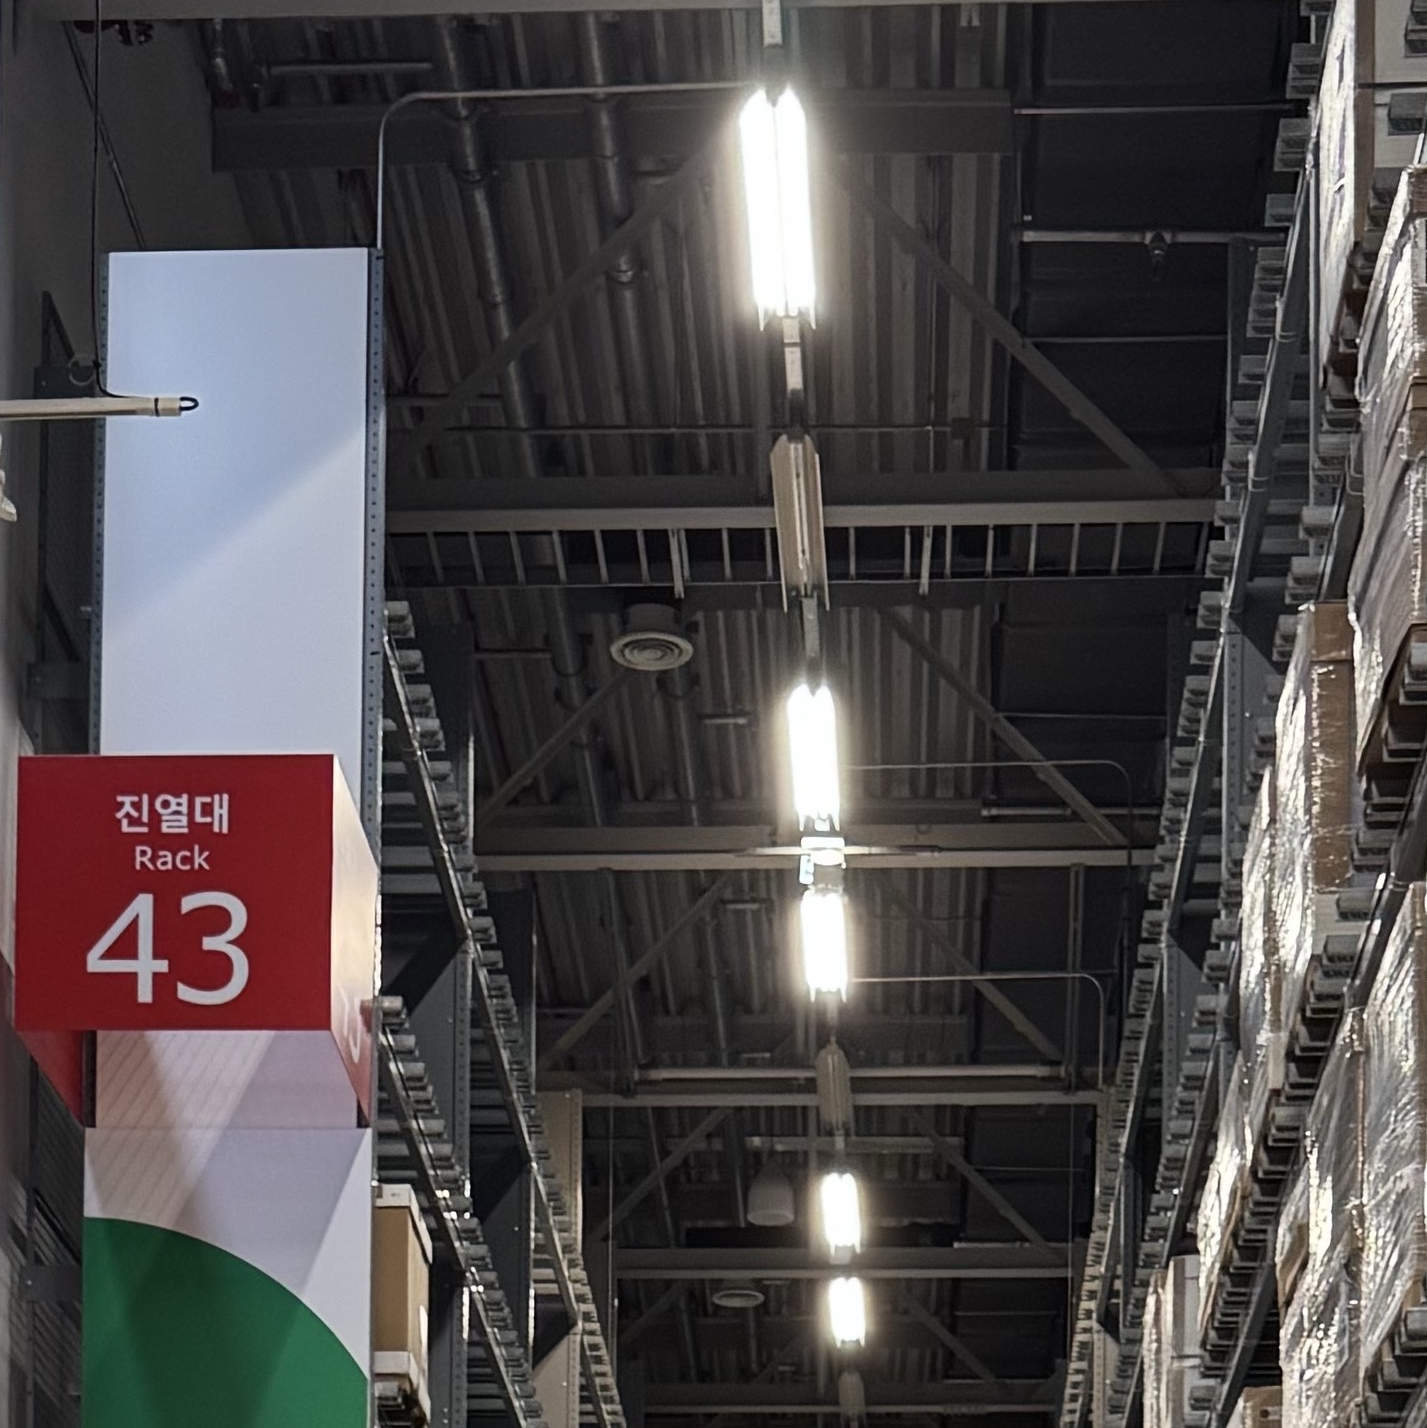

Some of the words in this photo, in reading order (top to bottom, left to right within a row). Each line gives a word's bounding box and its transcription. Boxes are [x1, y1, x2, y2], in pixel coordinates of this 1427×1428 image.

[114, 792, 230, 835] 진열대
[134, 845, 211, 871] Rack
[85, 891, 251, 1006] 43
